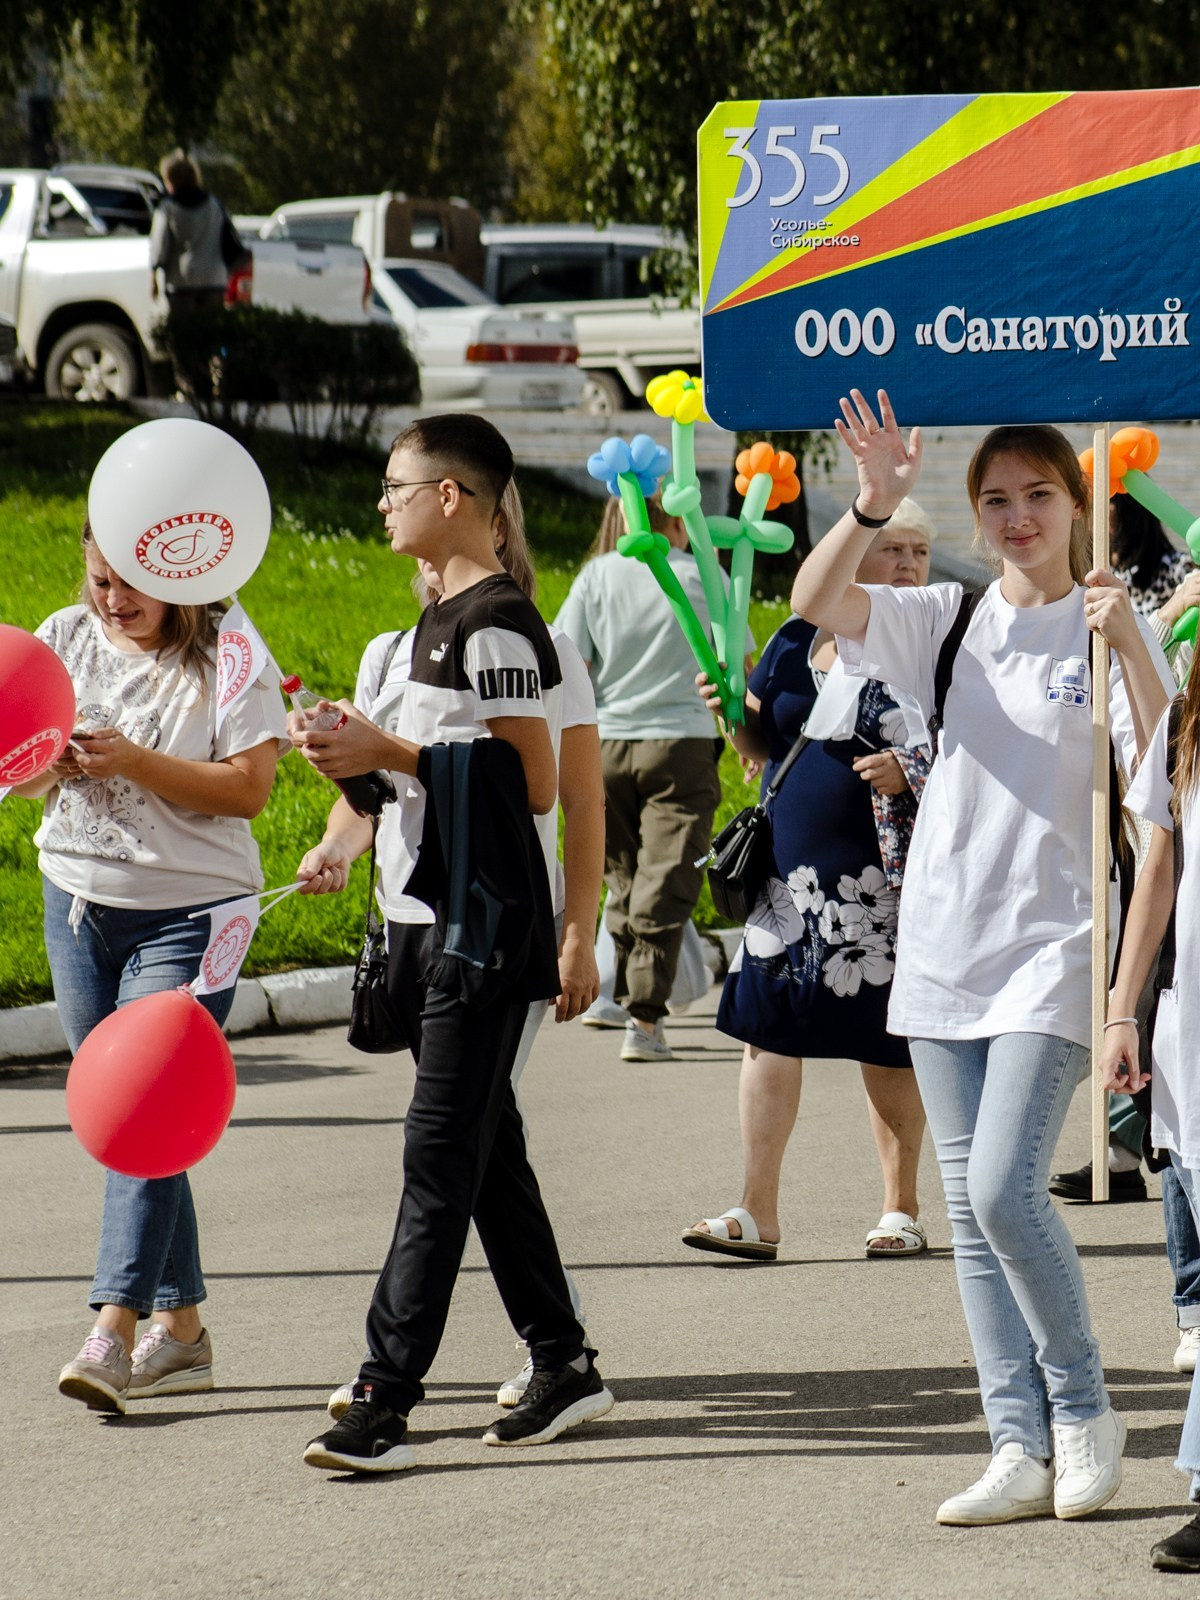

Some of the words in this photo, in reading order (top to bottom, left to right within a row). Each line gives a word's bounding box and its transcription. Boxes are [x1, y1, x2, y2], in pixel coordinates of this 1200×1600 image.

[723, 124, 850, 208] 355
[769, 217, 833, 232] Усолье-
[769, 234, 861, 250] Сибирское
[794, 307, 896, 357] ООО
[915, 297, 1191, 362] «Санаторий
[136, 513, 226, 551] УСОЛЬСКИЙ
[138, 526, 233, 579] СВИНОКОМПЛЕКС
[477, 667, 541, 701] UMA
[0, 730, 51, 767] ЛЬСКИЙ
